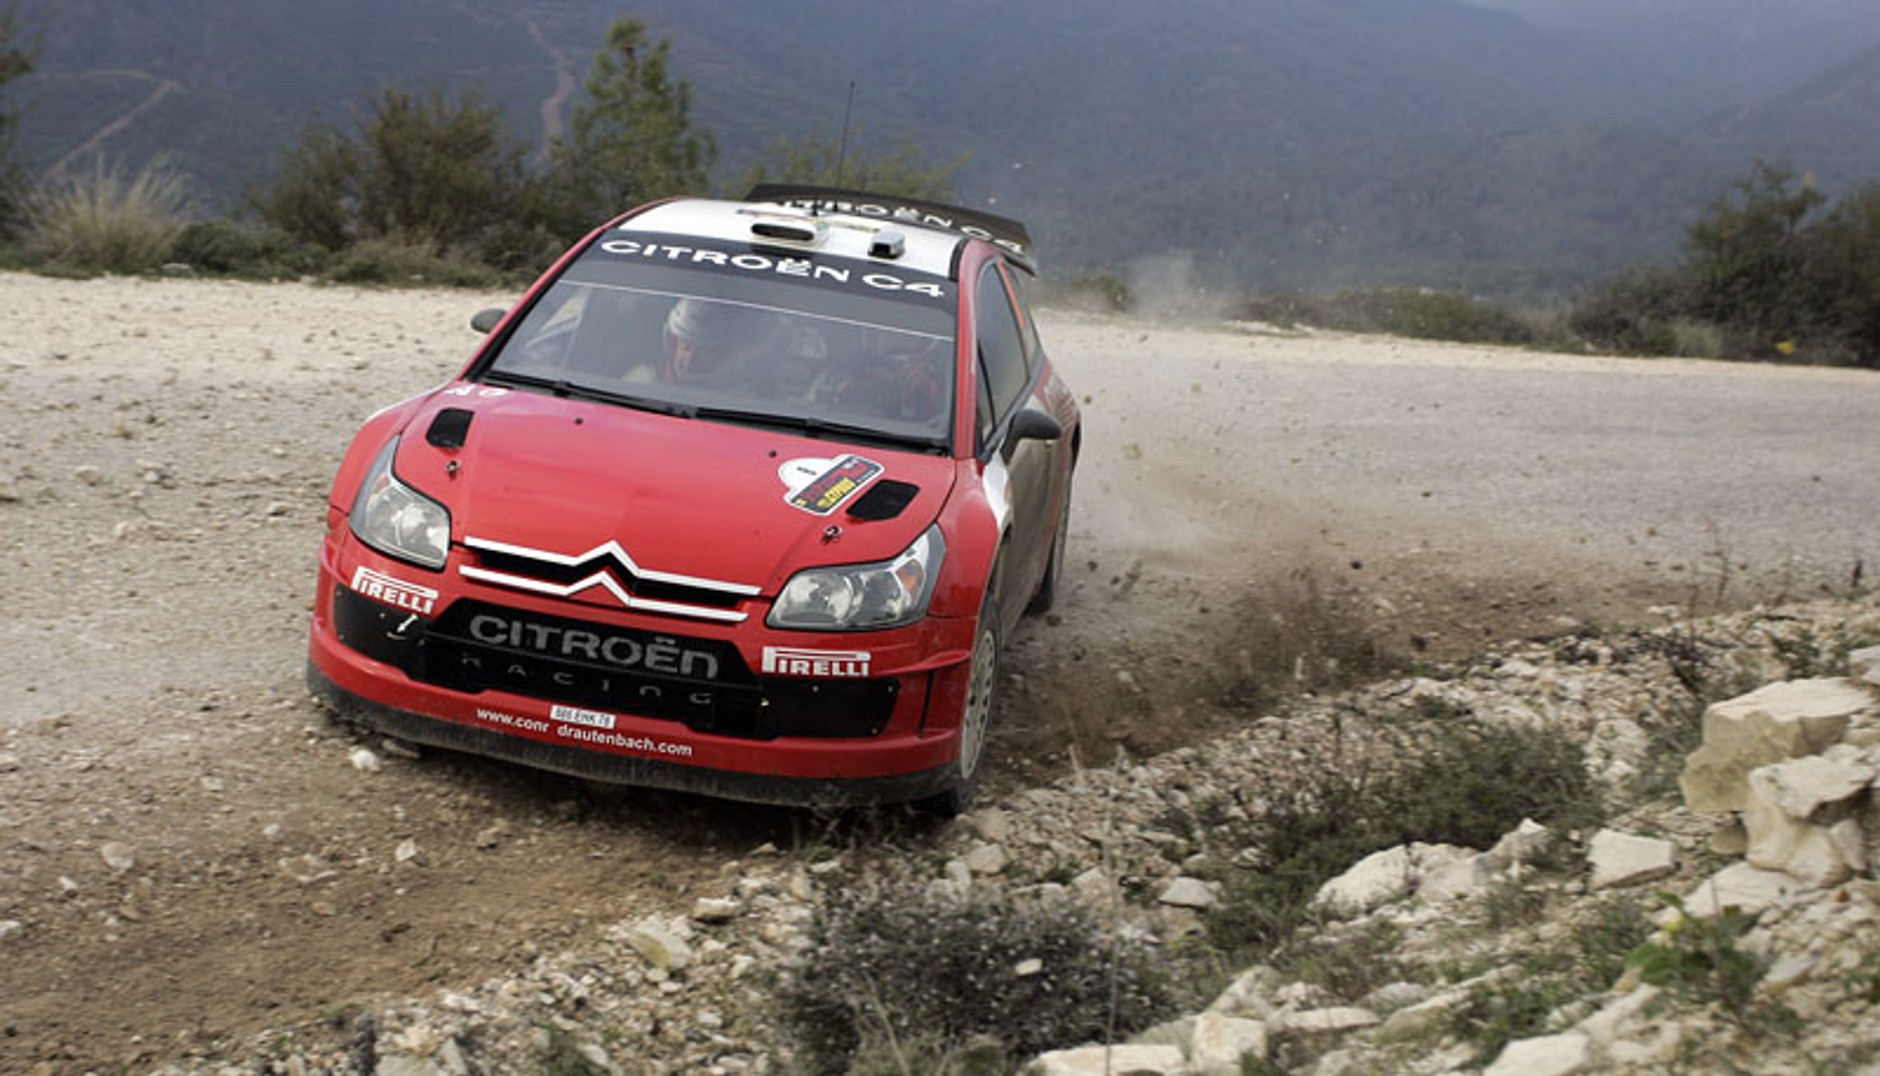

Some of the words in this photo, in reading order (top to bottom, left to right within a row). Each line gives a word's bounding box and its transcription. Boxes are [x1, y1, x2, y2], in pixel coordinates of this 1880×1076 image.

[601, 239, 851, 284] CITROËN
[861, 272, 946, 299] C4
[350, 566, 440, 615] PIRELLI
[761, 646, 872, 677] PIRELLI
[556, 723, 694, 757] drautenbach.com
